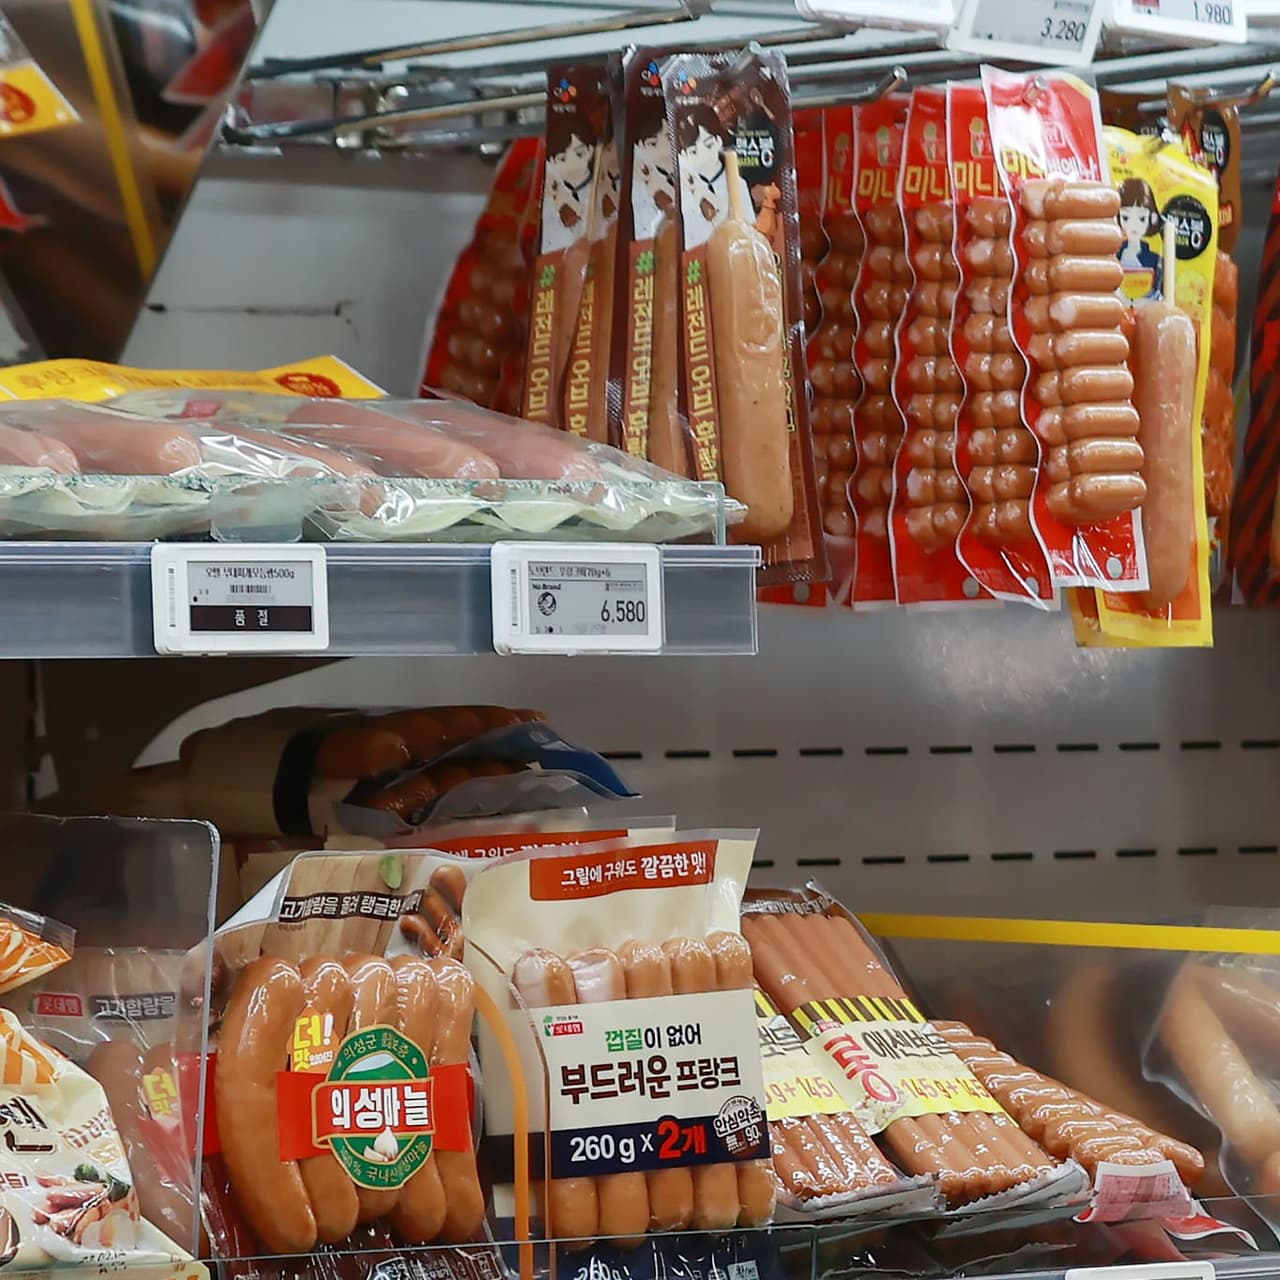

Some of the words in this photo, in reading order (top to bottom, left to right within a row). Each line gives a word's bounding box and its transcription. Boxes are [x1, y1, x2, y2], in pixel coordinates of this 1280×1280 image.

[561, 865, 602, 886] 그릴에
[604, 860, 637, 881] 구워도
[641, 853, 689, 879] 깔끔한
[691, 852, 706, 875] 맛!
[605, 1027, 661, 1052] 껍질이
[666, 1023, 702, 1047] 없어
[561, 1055, 671, 1105] 부드러운
[676, 1056, 742, 1092] 프랑크
[331, 1085, 430, 1130] 의성마늘
[657, 1120, 708, 1159] 2개
